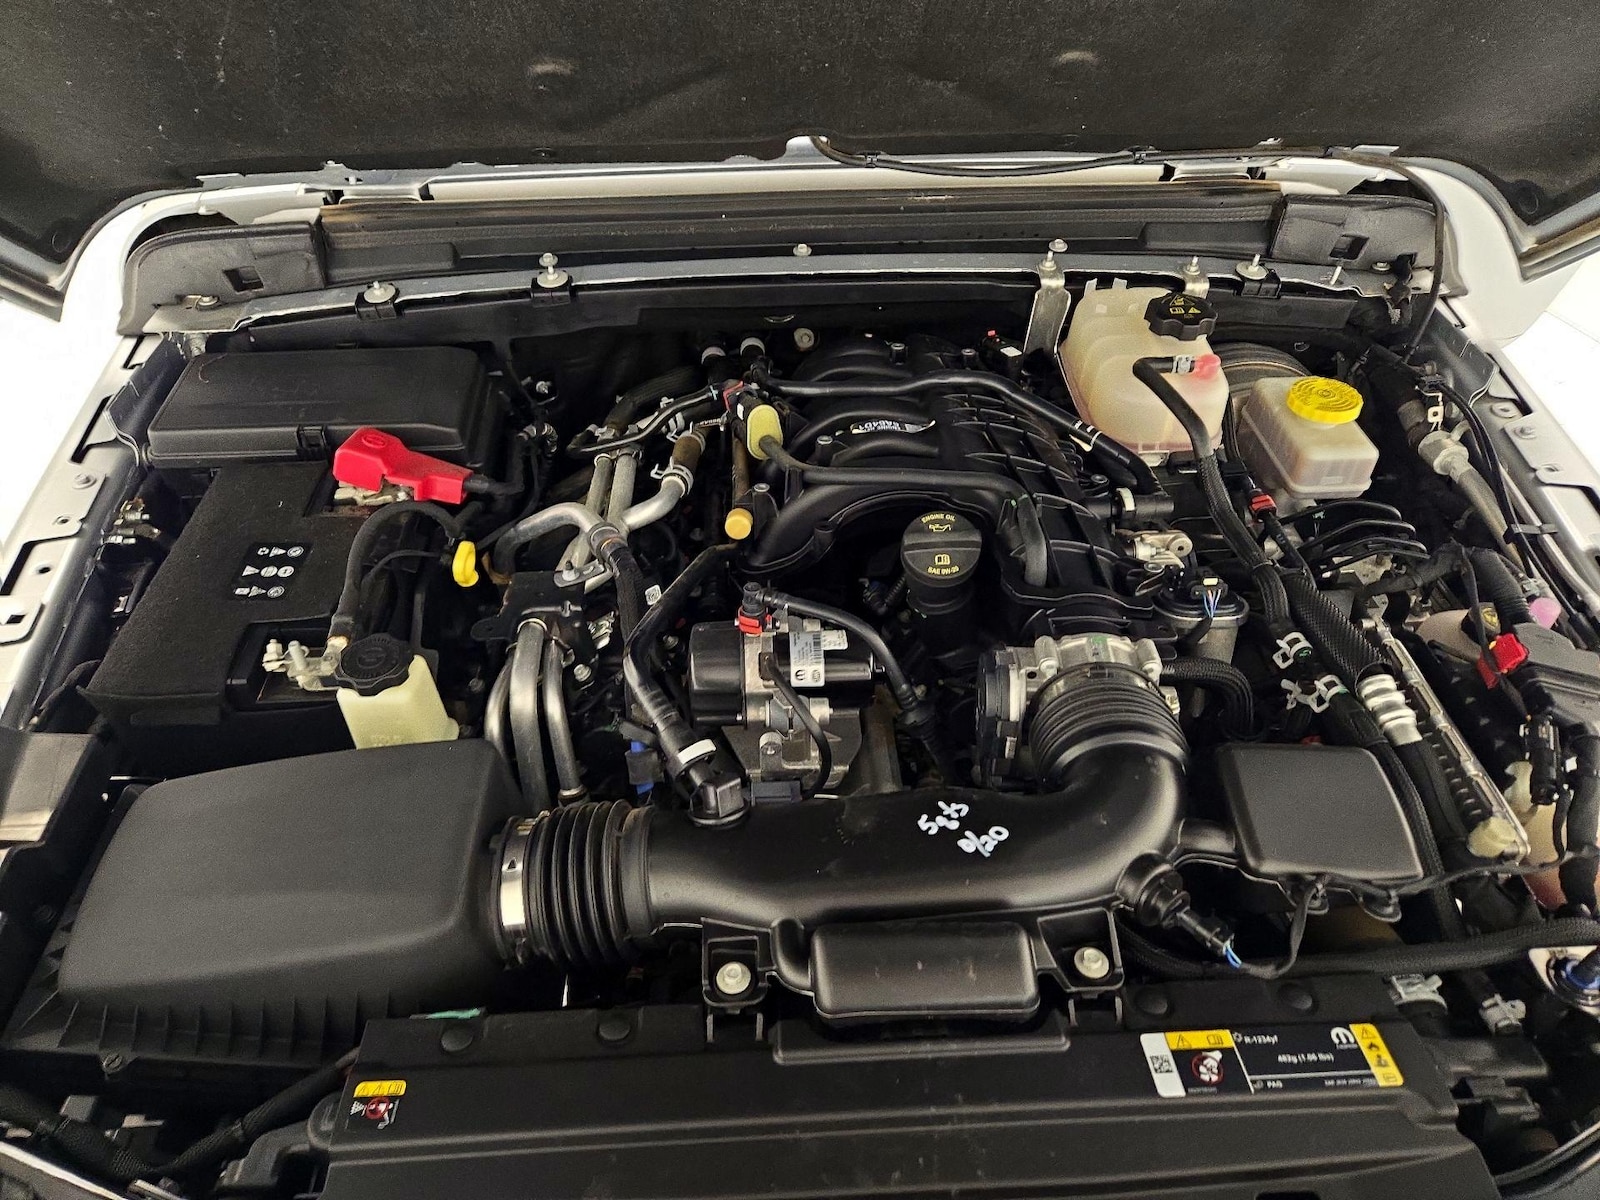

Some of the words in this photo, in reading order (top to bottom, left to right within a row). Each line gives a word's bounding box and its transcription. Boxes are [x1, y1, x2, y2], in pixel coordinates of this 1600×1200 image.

[921, 513, 945, 524] ENGINE
[945, 514, 956, 522] OIL
[927, 566, 940, 575] SAE
